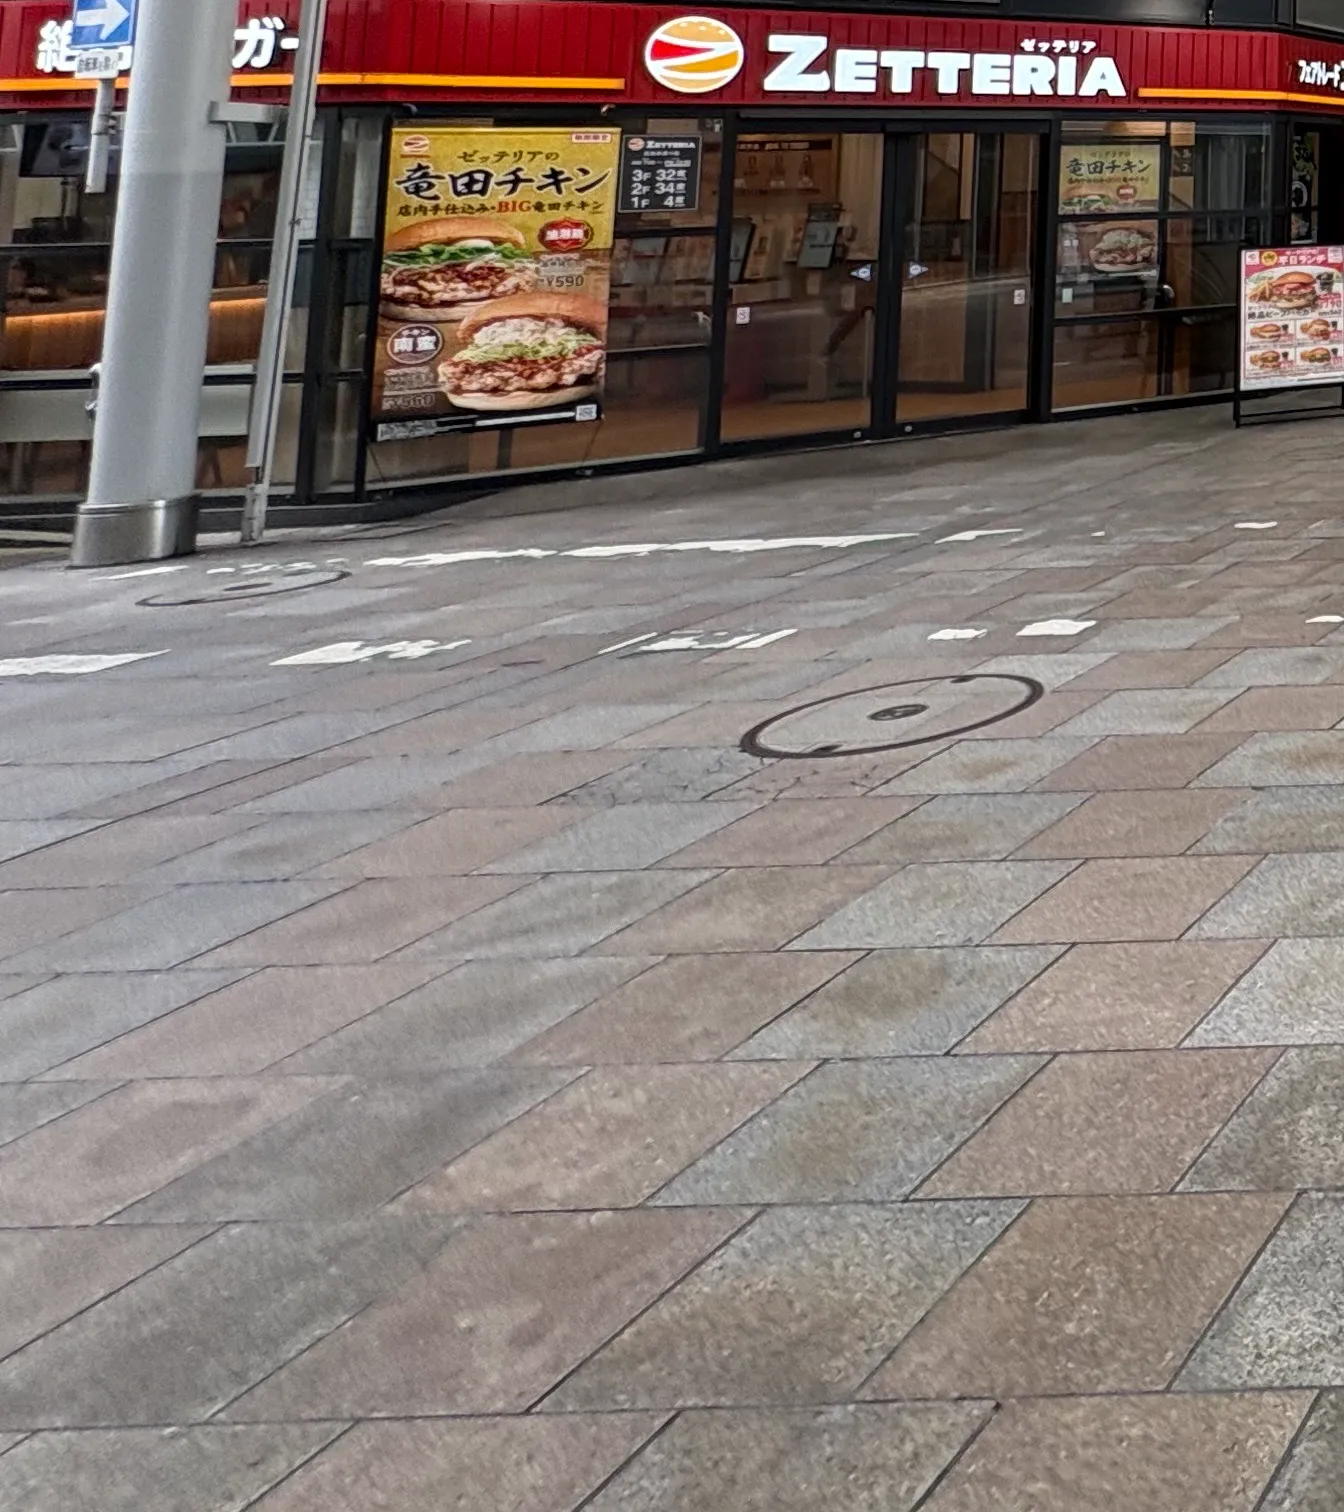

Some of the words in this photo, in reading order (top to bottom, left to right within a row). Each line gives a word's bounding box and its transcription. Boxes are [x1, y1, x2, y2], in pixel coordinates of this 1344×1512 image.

[1019, 38, 1097, 54] ゼッテリア
[764, 34, 1127, 98] ZETTERIA
[457, 150, 560, 164] ゼッテリアの
[1066, 158, 1151, 176] 竜田チキン
[395, 163, 614, 201] 竜田チキン
